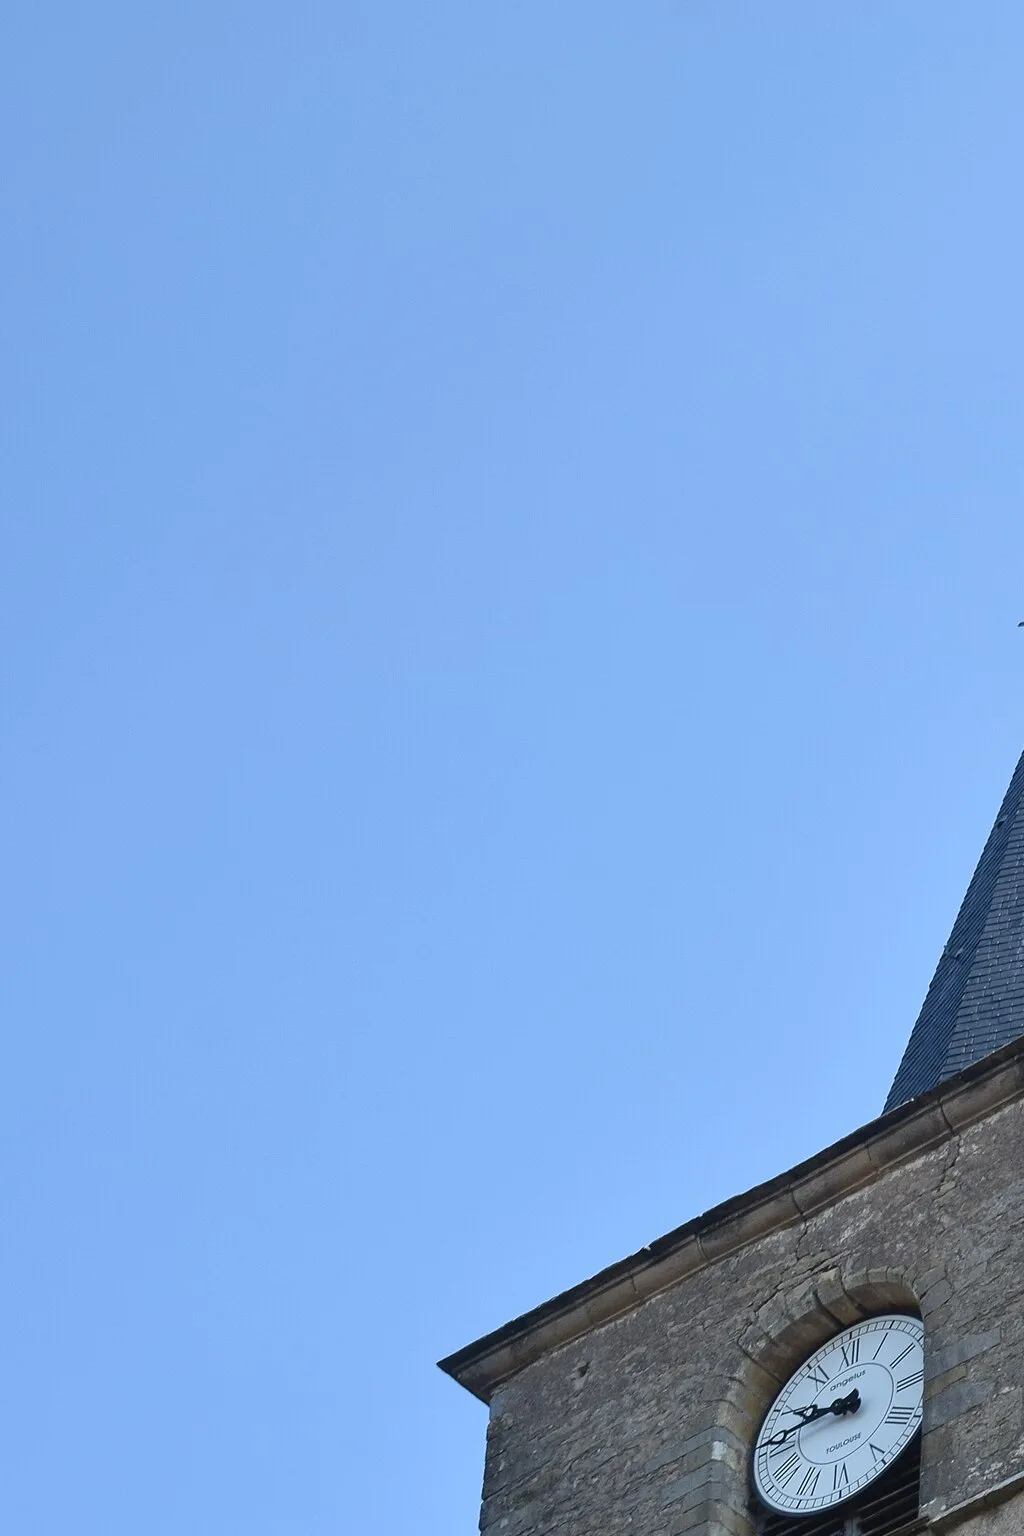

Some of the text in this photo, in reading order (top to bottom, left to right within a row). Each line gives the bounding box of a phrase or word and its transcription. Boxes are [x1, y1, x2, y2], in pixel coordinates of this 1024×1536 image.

[839, 1338, 859, 1371] XII
[807, 1365, 829, 1392] XI
[829, 1370, 866, 1392] angelus
[826, 1432, 862, 1455] TOULOUSE
[869, 1443, 884, 1462] V
